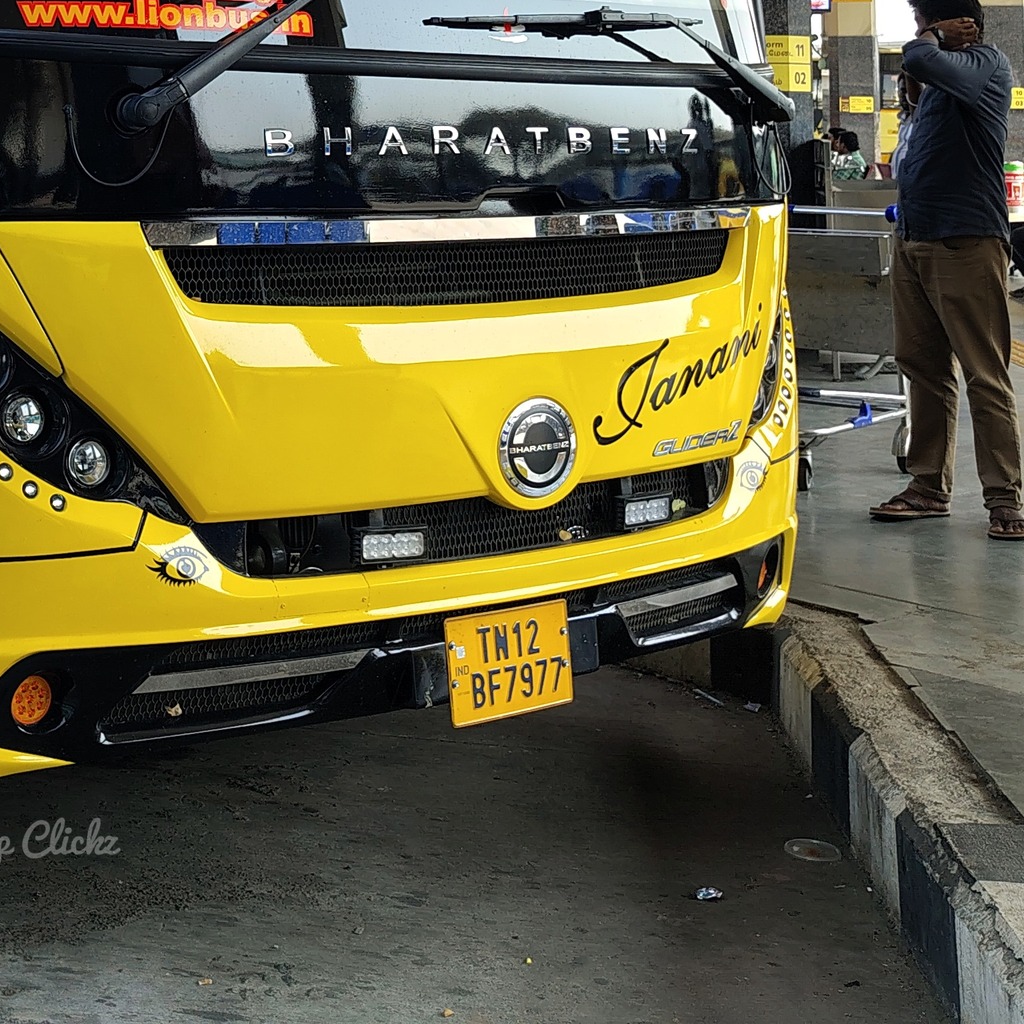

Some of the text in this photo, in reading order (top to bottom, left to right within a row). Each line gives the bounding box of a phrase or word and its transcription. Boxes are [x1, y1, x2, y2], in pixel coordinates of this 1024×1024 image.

[795, 44, 805, 57] 11
[794, 71, 807, 85] 02
[264, 125, 699, 157] BHARATBENZ
[593, 302, 763, 445] Janani
[509, 440, 570, 454] BHARATBENZ
[477, 618, 540, 664] TN12
[454, 665, 470, 677] IND
[471, 655, 563, 709] BF7977
